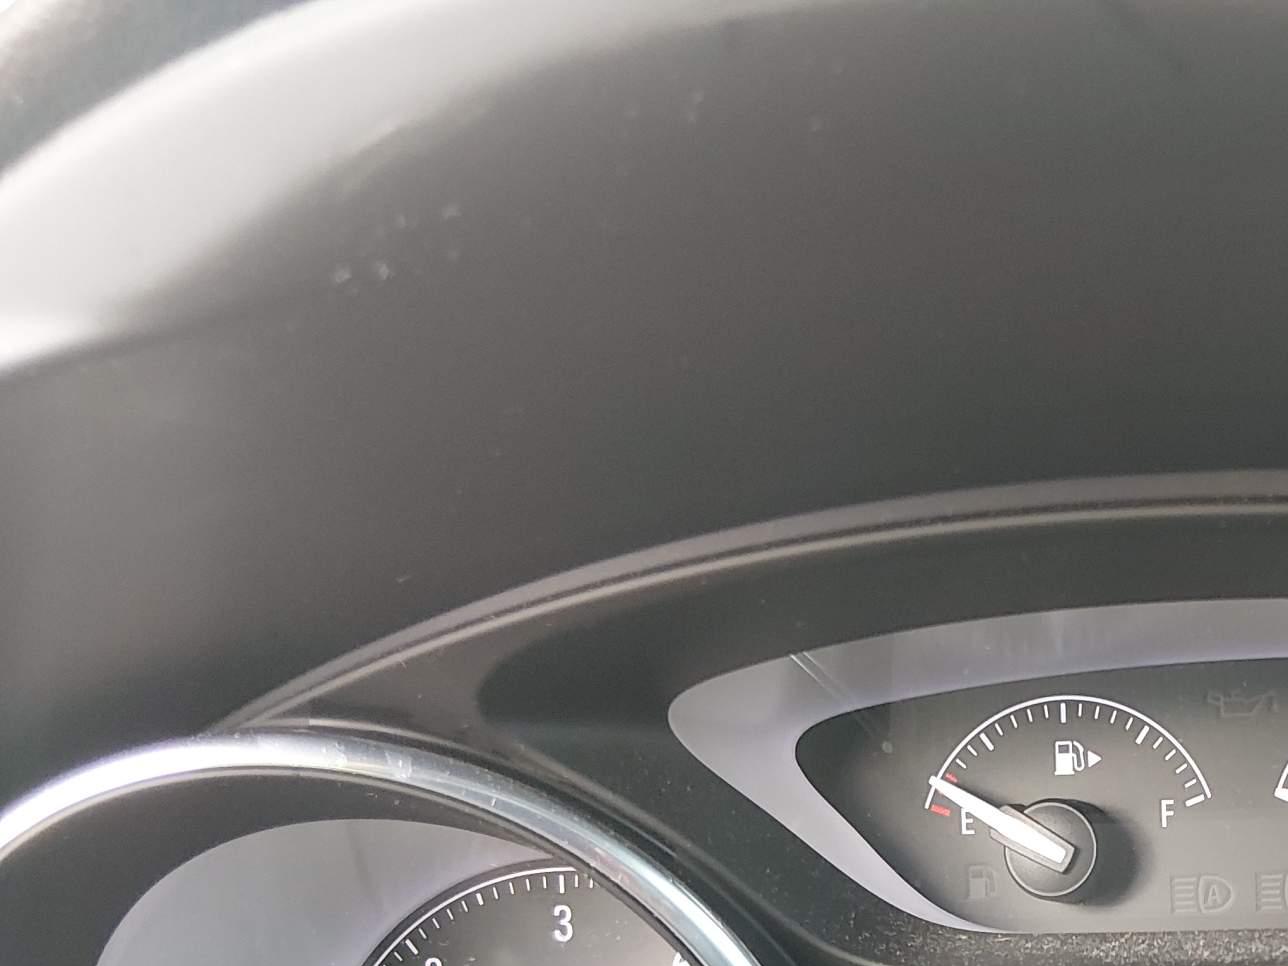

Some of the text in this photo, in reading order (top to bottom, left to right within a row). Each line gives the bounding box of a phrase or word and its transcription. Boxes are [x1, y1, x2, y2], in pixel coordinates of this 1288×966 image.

[960, 805, 976, 835] E
[1162, 799, 1175, 827] F
[553, 904, 574, 942] 3
